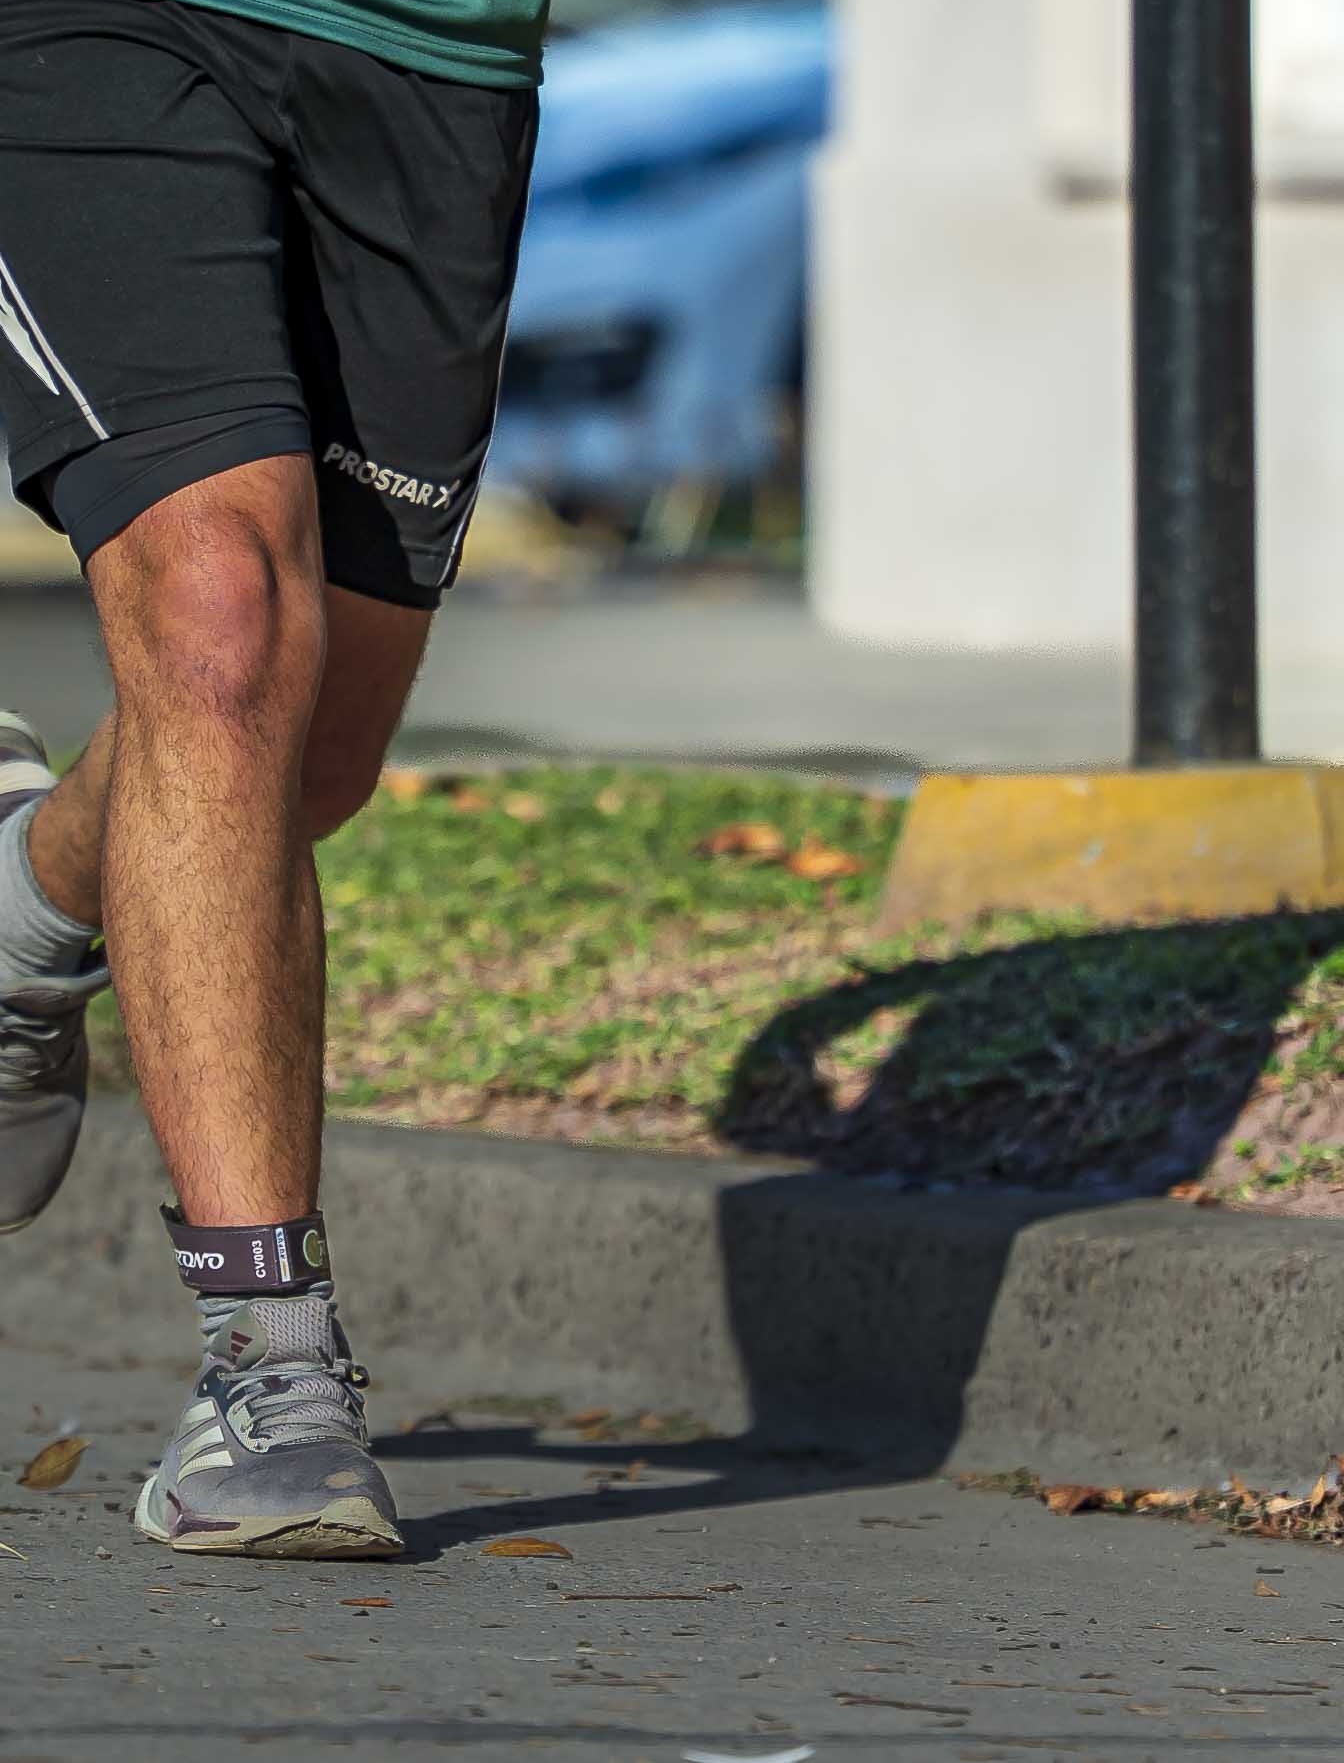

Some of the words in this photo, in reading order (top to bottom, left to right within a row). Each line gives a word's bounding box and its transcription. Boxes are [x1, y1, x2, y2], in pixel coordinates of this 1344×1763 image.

[323, 442, 434, 506] PROSTAR
[175, 1248, 225, 1270] RONO
[251, 1240, 267, 1279] CV003
